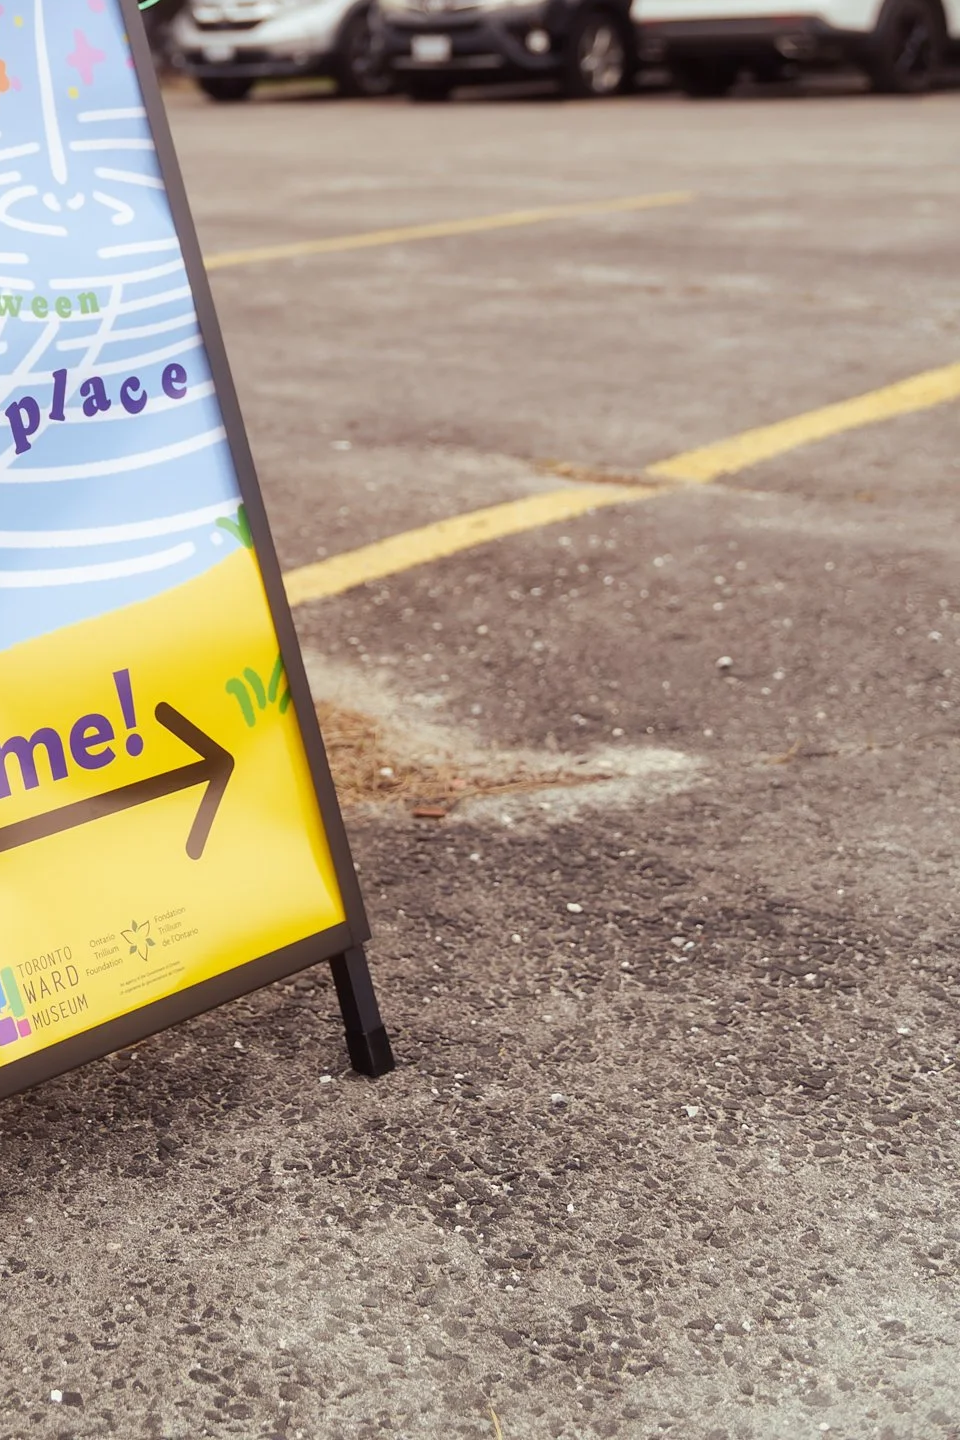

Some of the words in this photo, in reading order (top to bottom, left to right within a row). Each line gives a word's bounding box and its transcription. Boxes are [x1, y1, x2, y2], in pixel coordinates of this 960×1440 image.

[4, 363, 188, 455] place
[154, 907, 186, 923] Fondation
[158, 921, 182, 935] Trillium
[89, 933, 116, 948] Ontario
[93, 945, 120, 960] Trillium
[17, 946, 72, 978] TORONTO
[85, 958, 124, 976] Foundation
[22, 965, 79, 1004] WARD
[32, 993, 89, 1030] MUSEUM
